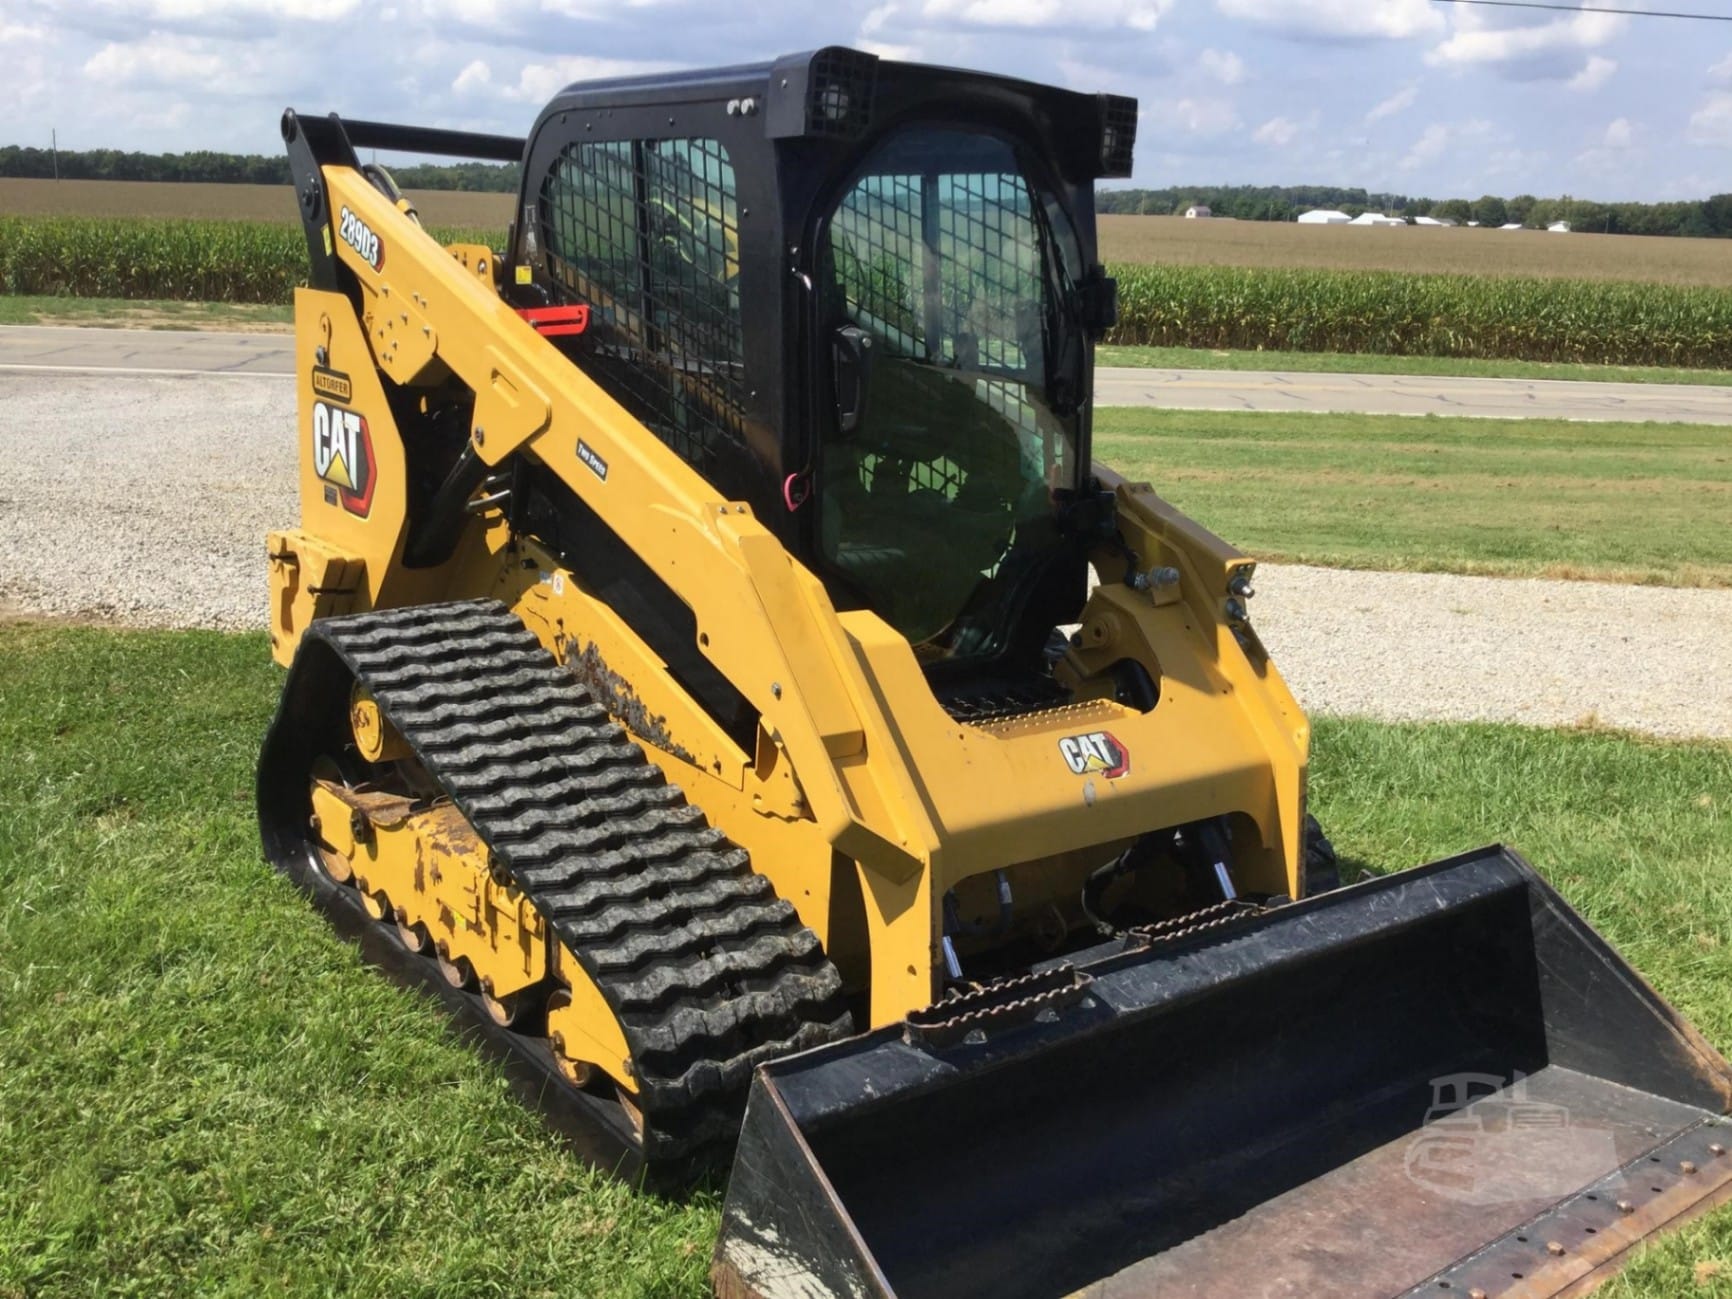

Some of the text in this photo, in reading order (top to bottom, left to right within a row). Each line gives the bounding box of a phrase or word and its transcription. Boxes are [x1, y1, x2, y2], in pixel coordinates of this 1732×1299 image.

[340, 207, 378, 266] 289D3
[315, 374, 349, 395] ALTORFER
[314, 402, 360, 491] CAT
[1059, 733, 1114, 773] CAT
